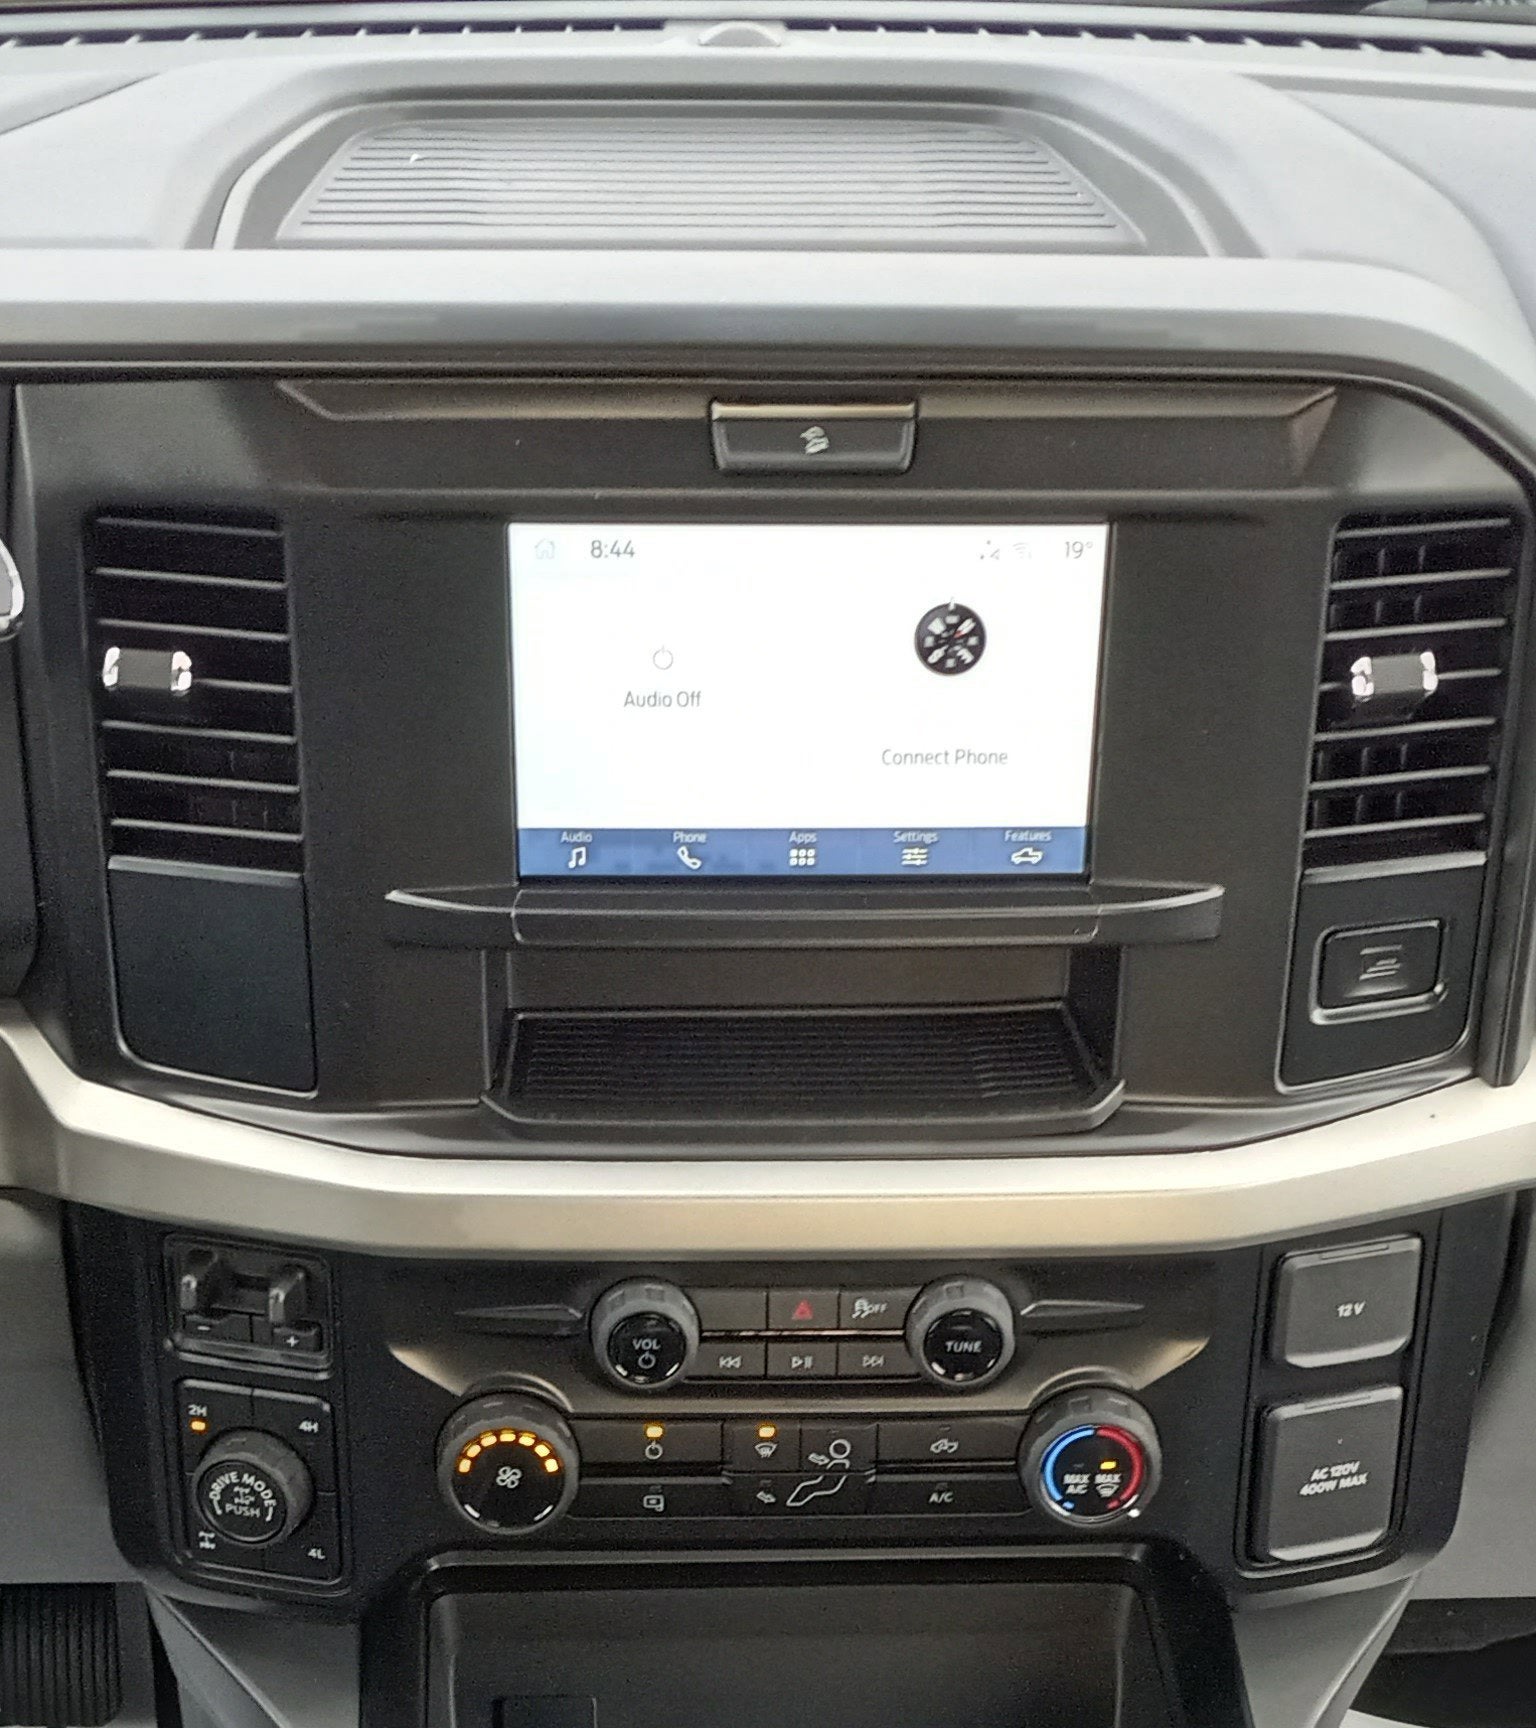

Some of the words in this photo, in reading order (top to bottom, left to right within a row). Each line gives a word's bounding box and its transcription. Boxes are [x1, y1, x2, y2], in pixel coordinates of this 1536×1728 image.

[590, 539, 635, 559] 8:44
[623, 690, 672, 709] Audio
[675, 690, 703, 709] Off
[881, 748, 949, 767] Connect
[954, 748, 1008, 768] Phone
[561, 831, 593, 844] Audio
[673, 831, 707, 844] Phone
[789, 831, 817, 846] Apps
[893, 831, 938, 846] Settings
[1004, 829, 1051, 842] Features
[633, 1338, 661, 1351] VOL
[945, 1340, 982, 1353] TUNE
[188, 1404, 207, 1417] 2H
[298, 1420, 319, 1433] 4H
[1311, 1468, 1330, 1481] AC
[1330, 1460, 1360, 1478] 120V
[1064, 1473, 1089, 1484] MAX
[1094, 1473, 1121, 1483] MAX
[1299, 1479, 1337, 1496] 400W
[1338, 1472, 1368, 1490] MAX
[209, 1471, 240, 1501] DRIVE
[241, 1473, 277, 1507] MODE
[929, 1491, 954, 1503] A/C
[225, 1503, 261, 1518] PUSH
[307, 1548, 326, 1559] 4L
